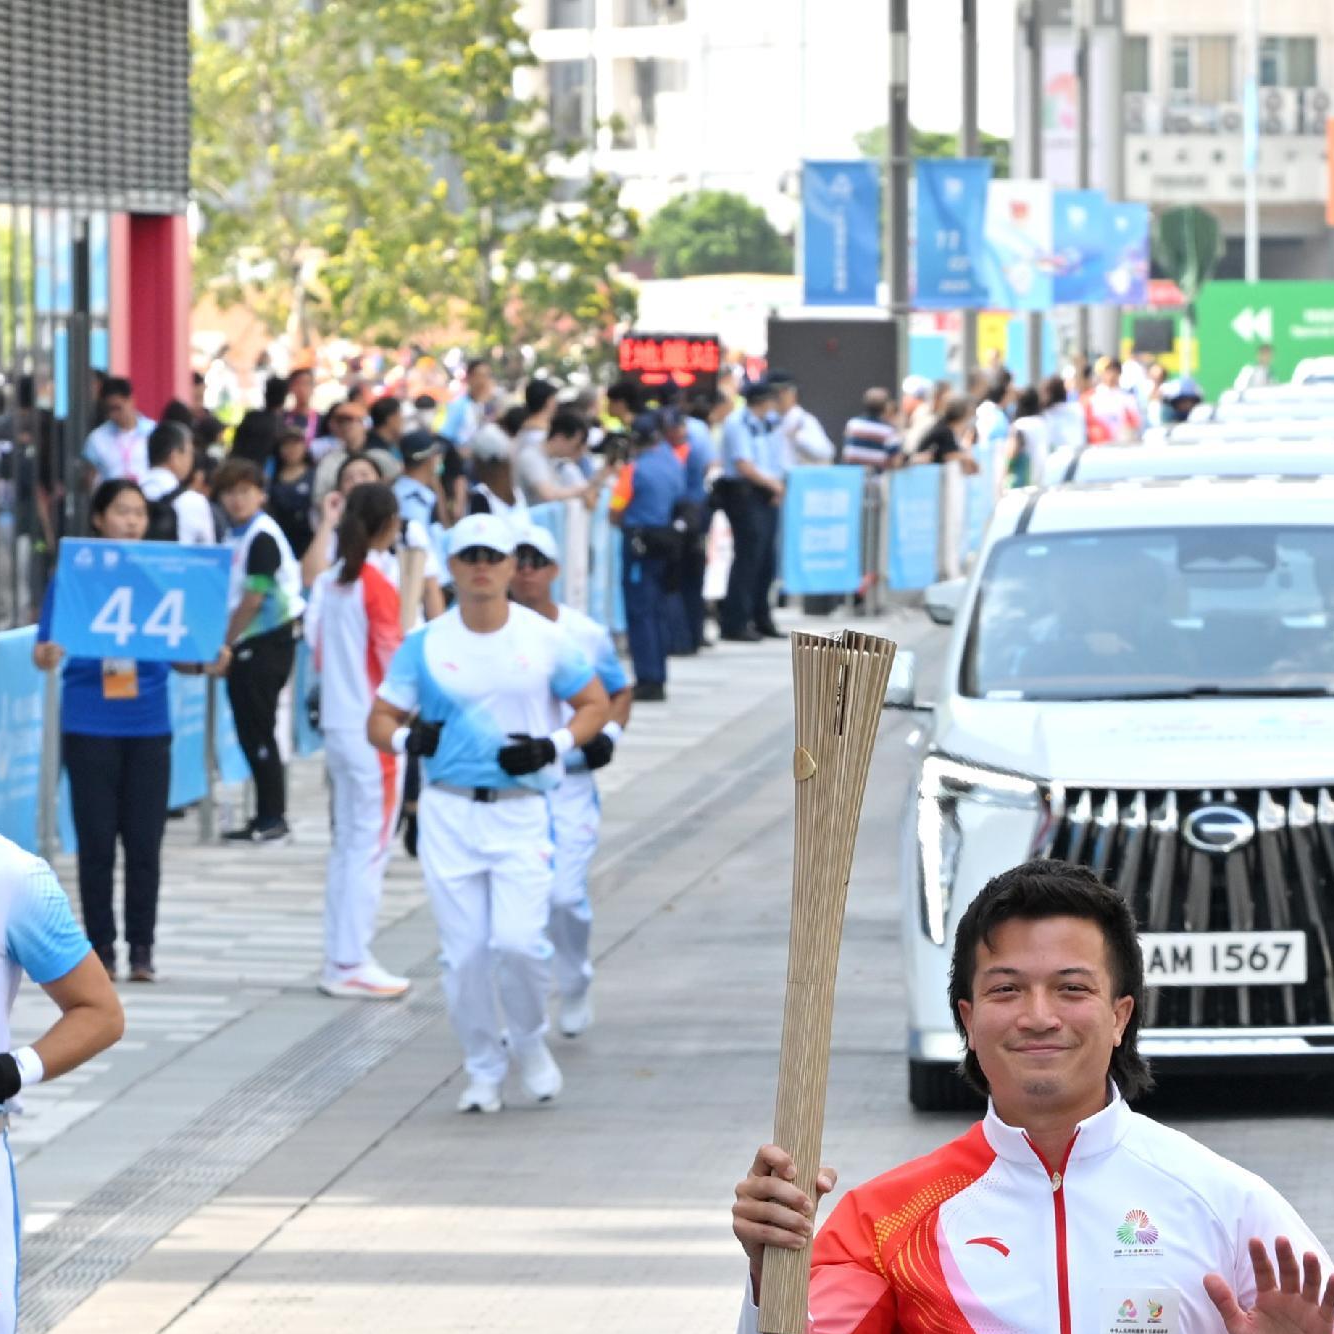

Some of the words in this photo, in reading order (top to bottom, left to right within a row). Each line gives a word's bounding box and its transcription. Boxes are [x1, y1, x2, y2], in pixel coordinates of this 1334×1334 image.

[89, 586, 189, 648] 44
[1148, 943, 1193, 974] AM
[1210, 942, 1293, 973] 1567
